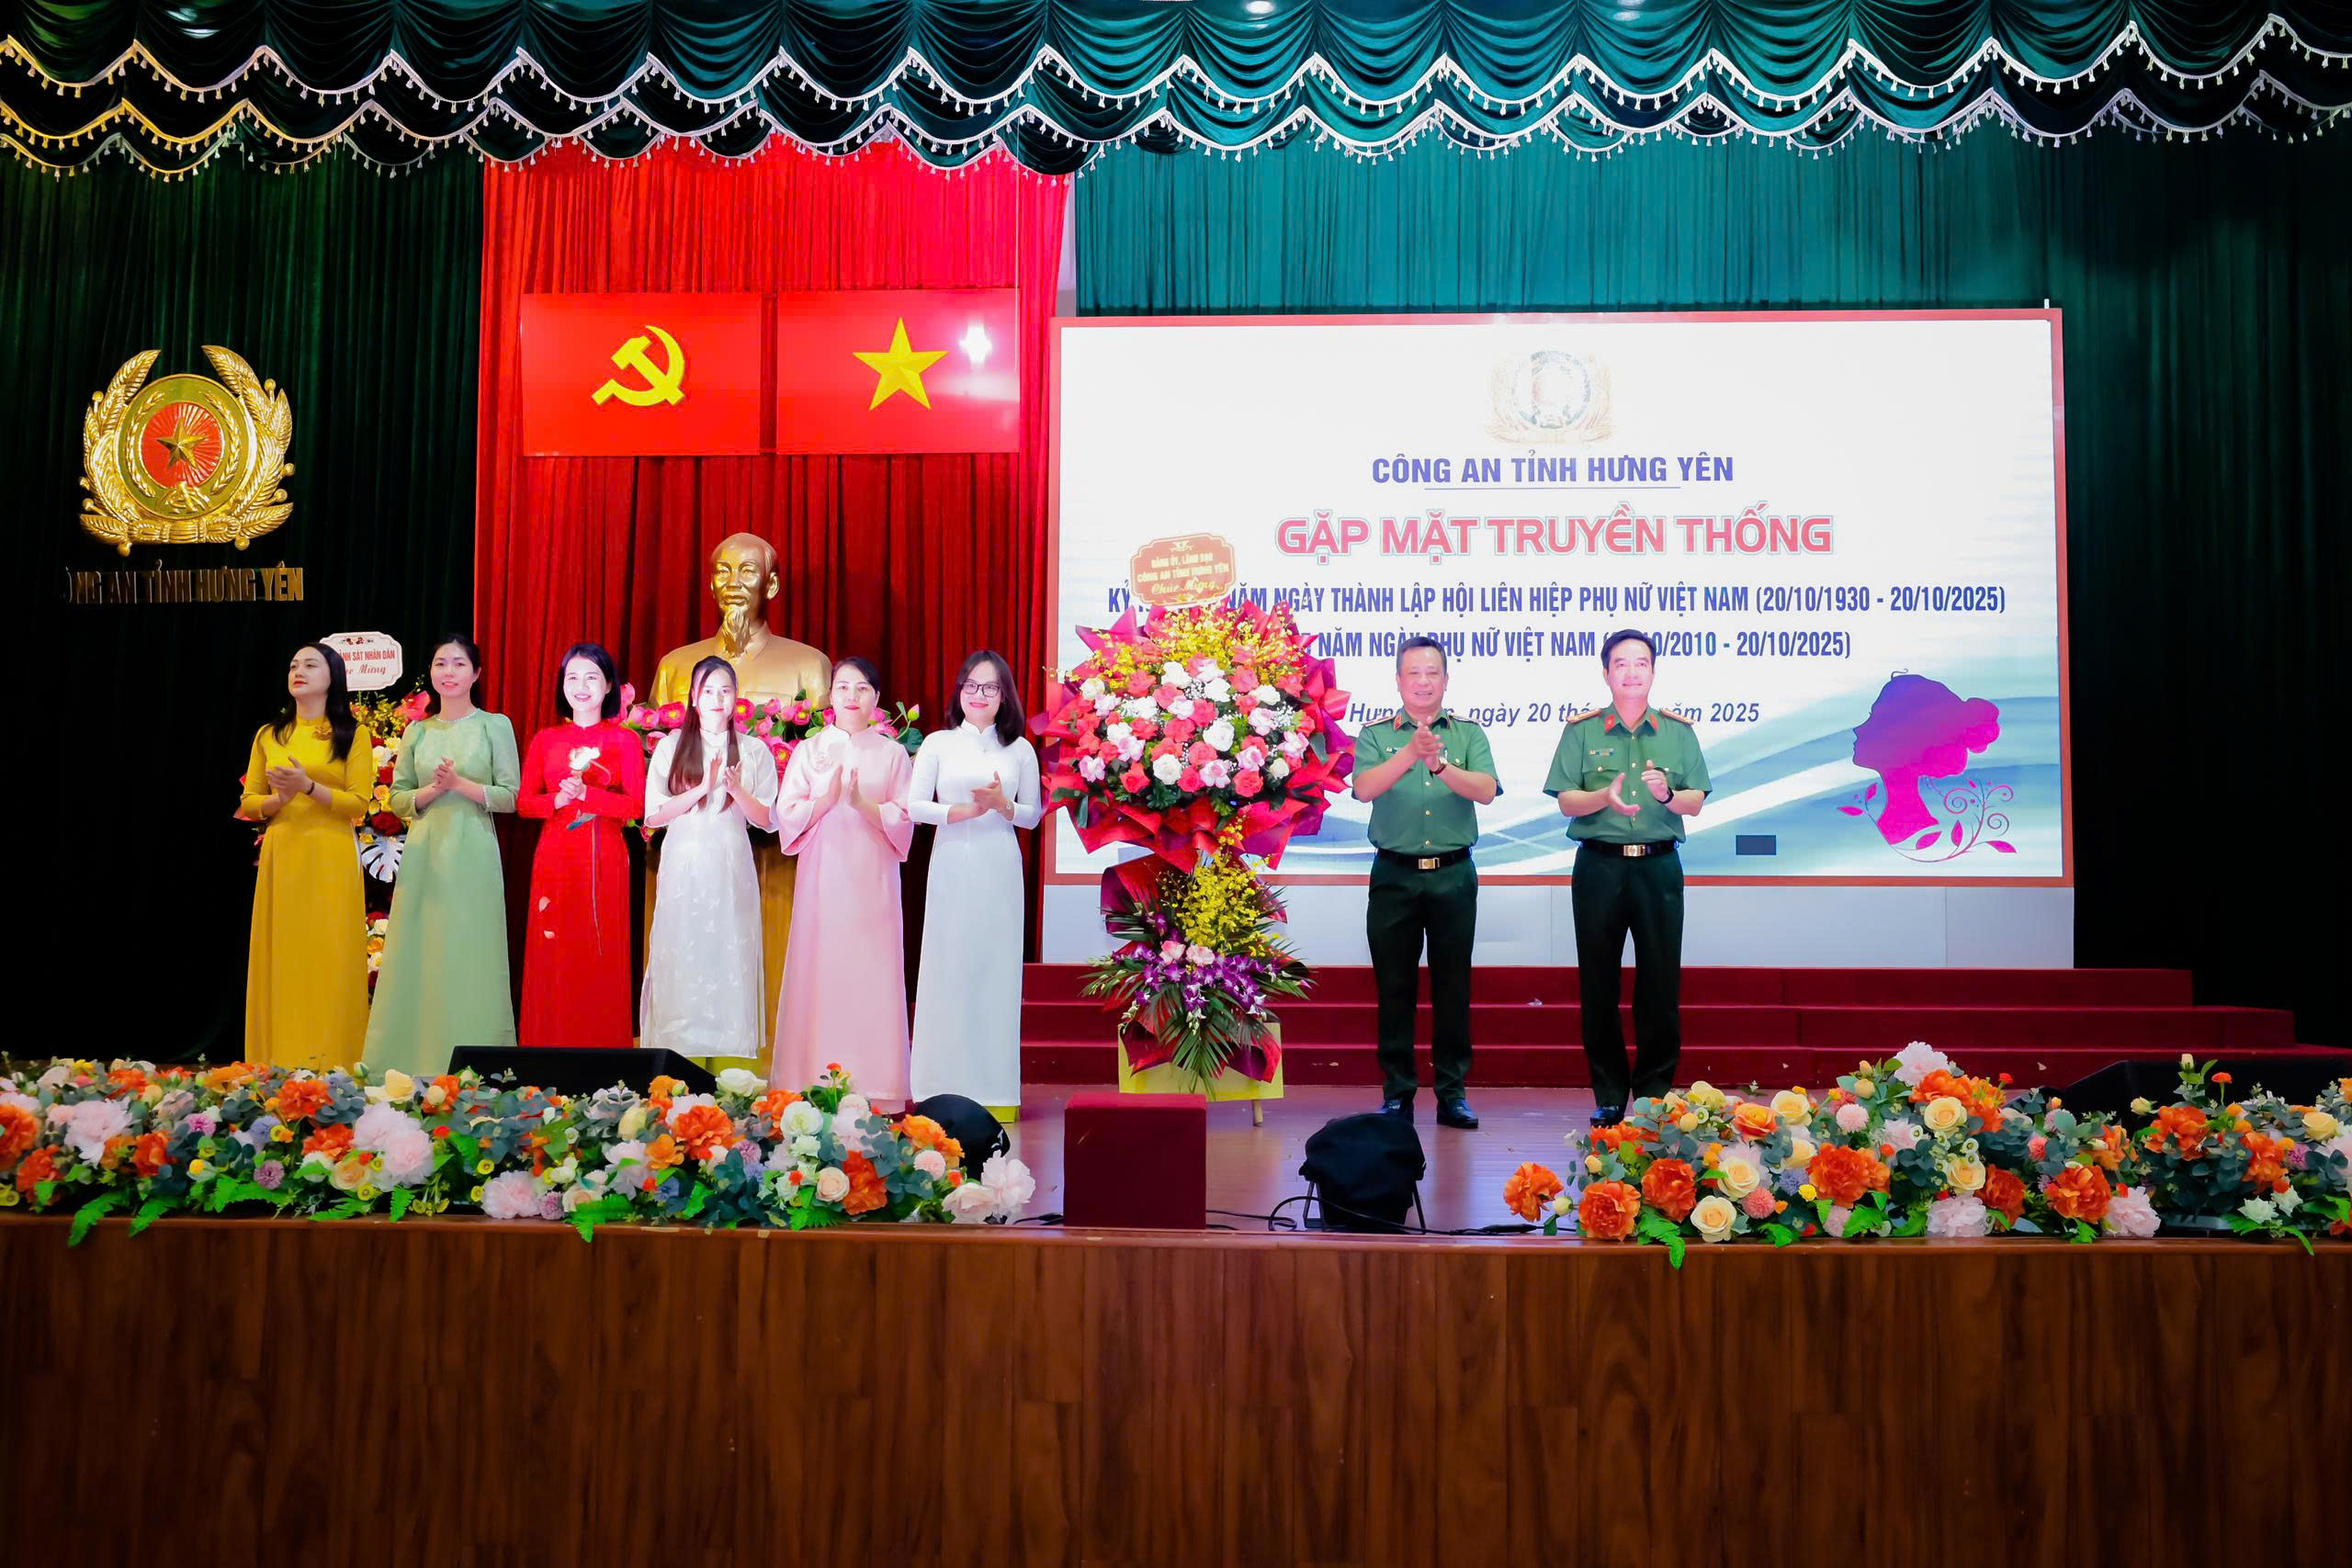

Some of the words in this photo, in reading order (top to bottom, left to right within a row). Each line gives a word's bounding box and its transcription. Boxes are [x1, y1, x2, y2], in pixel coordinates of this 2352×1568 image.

[1372, 453, 1451, 483] CÔNG
[1461, 457, 1501, 483] AN
[1510, 449, 1577, 482] TỈNH
[1588, 454, 1667, 482] HƯNG
[1677, 451, 1734, 481] YÊN
[1276, 511, 1370, 563] GẶP
[1382, 511, 1478, 563] MẶT
[1487, 503, 1665, 553] TRUYỀN
[1675, 502, 1831, 553] THỐNG
[143, 558, 192, 604] TỈNH
[196, 564, 256, 603] HƯNG
[261, 559, 304, 602] YÊN
[1330, 581, 1394, 613] THÀNH
[1400, 581, 1436, 618] LẬP
[1442, 581, 1474, 618] HỘI
[1480, 581, 1522, 613] LIÊN
[1529, 581, 1573, 618] HIỆP
[1579, 586, 1618, 618] PHỤ
[1623, 581, 1654, 612] NỮ
[1657, 581, 1698, 617] VIỆT
[1703, 586, 1748, 612] NAM
[1756, 585, 1871, 615] (20/10/1930
[1890, 585, 2006, 615] 20/10/2025)
[1317, 626, 1363, 658] NĂM
[1369, 626, 1420, 658] NGÀ
[1471, 626, 1501, 658] NỮ
[1504, 626, 1545, 662] VIỆT
[1551, 631, 1596, 657] NAM
[1736, 630, 1850, 660] 20/10/2025)
[1349, 702, 1407, 723] Hưn
[1469, 702, 1521, 728] ngày
[1526, 702, 1552, 723] 20
[1661, 701, 1703, 723] ăm
[1709, 702, 1759, 723] 2025
